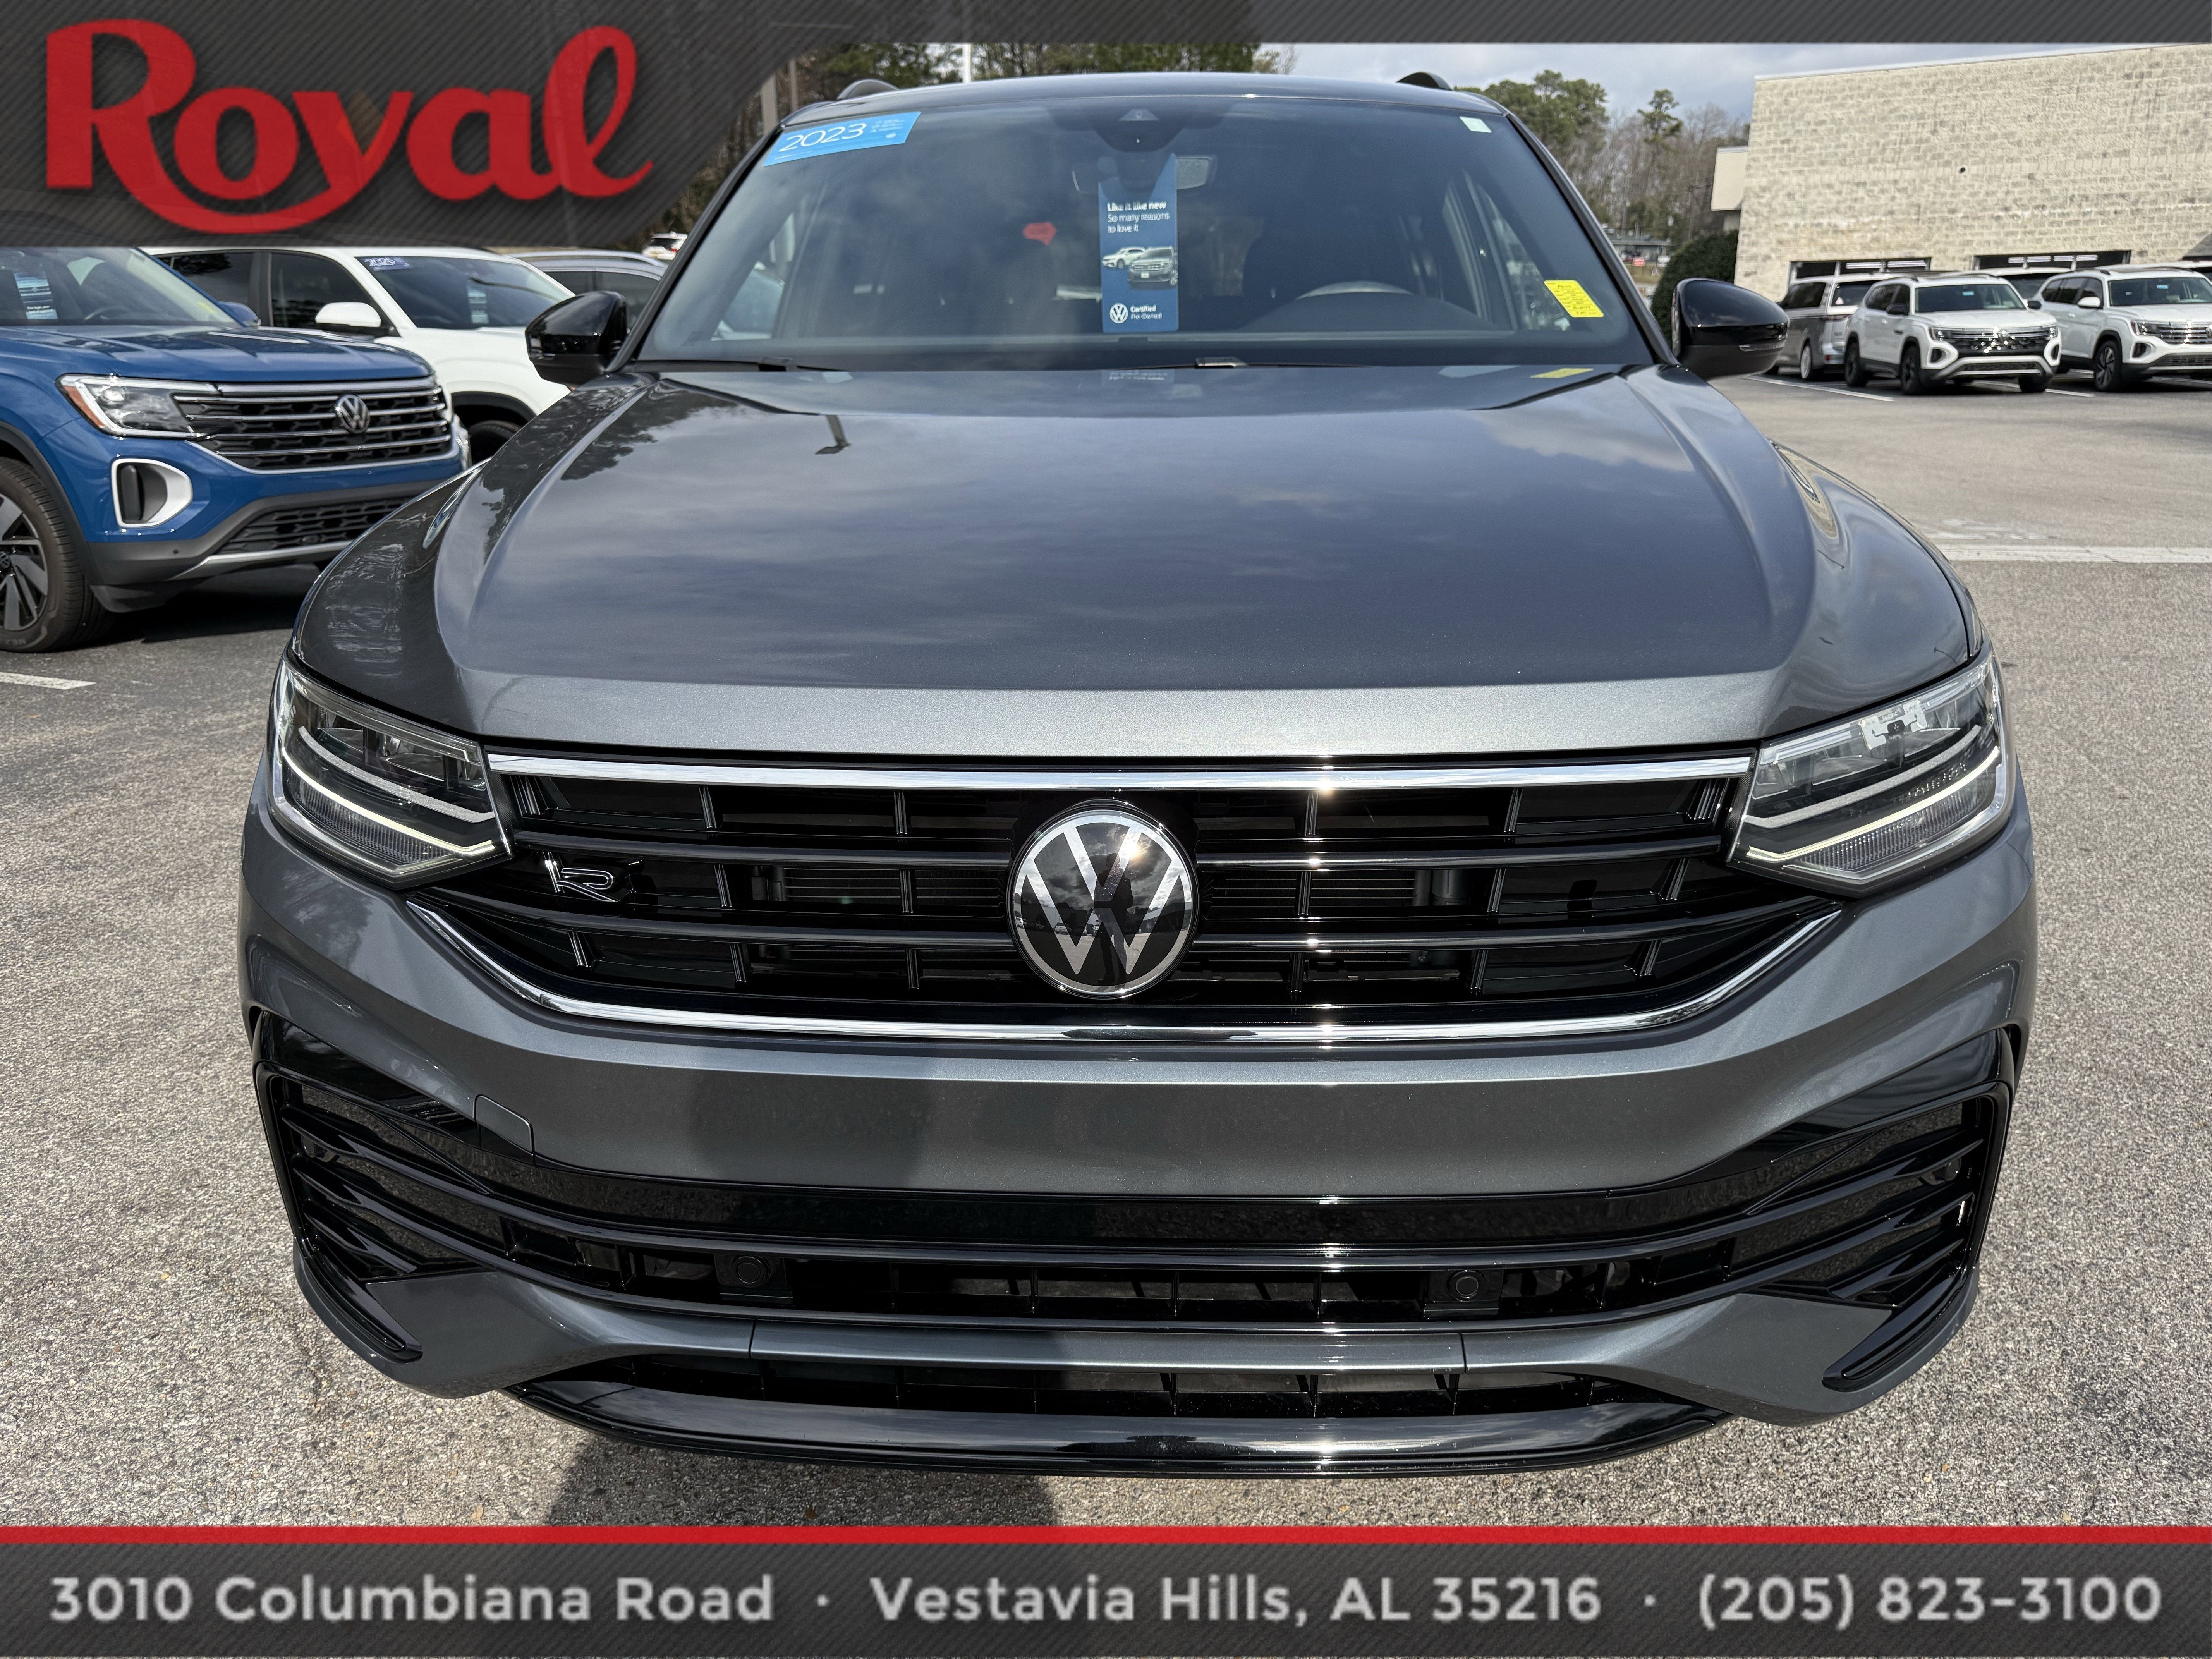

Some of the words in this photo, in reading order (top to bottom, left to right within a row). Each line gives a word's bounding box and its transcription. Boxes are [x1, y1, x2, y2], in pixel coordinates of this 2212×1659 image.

[779, 123, 867, 152] 2023
[1107, 201, 1123, 211] Like
[1148, 201, 1167, 210] new
[1108, 214, 1118, 222] So
[1119, 214, 1140, 223] many
[1141, 212, 1170, 221] reasons
[1108, 224, 1116, 233] to
[1116, 223, 1133, 232] love
[1133, 223, 1139, 232] it
